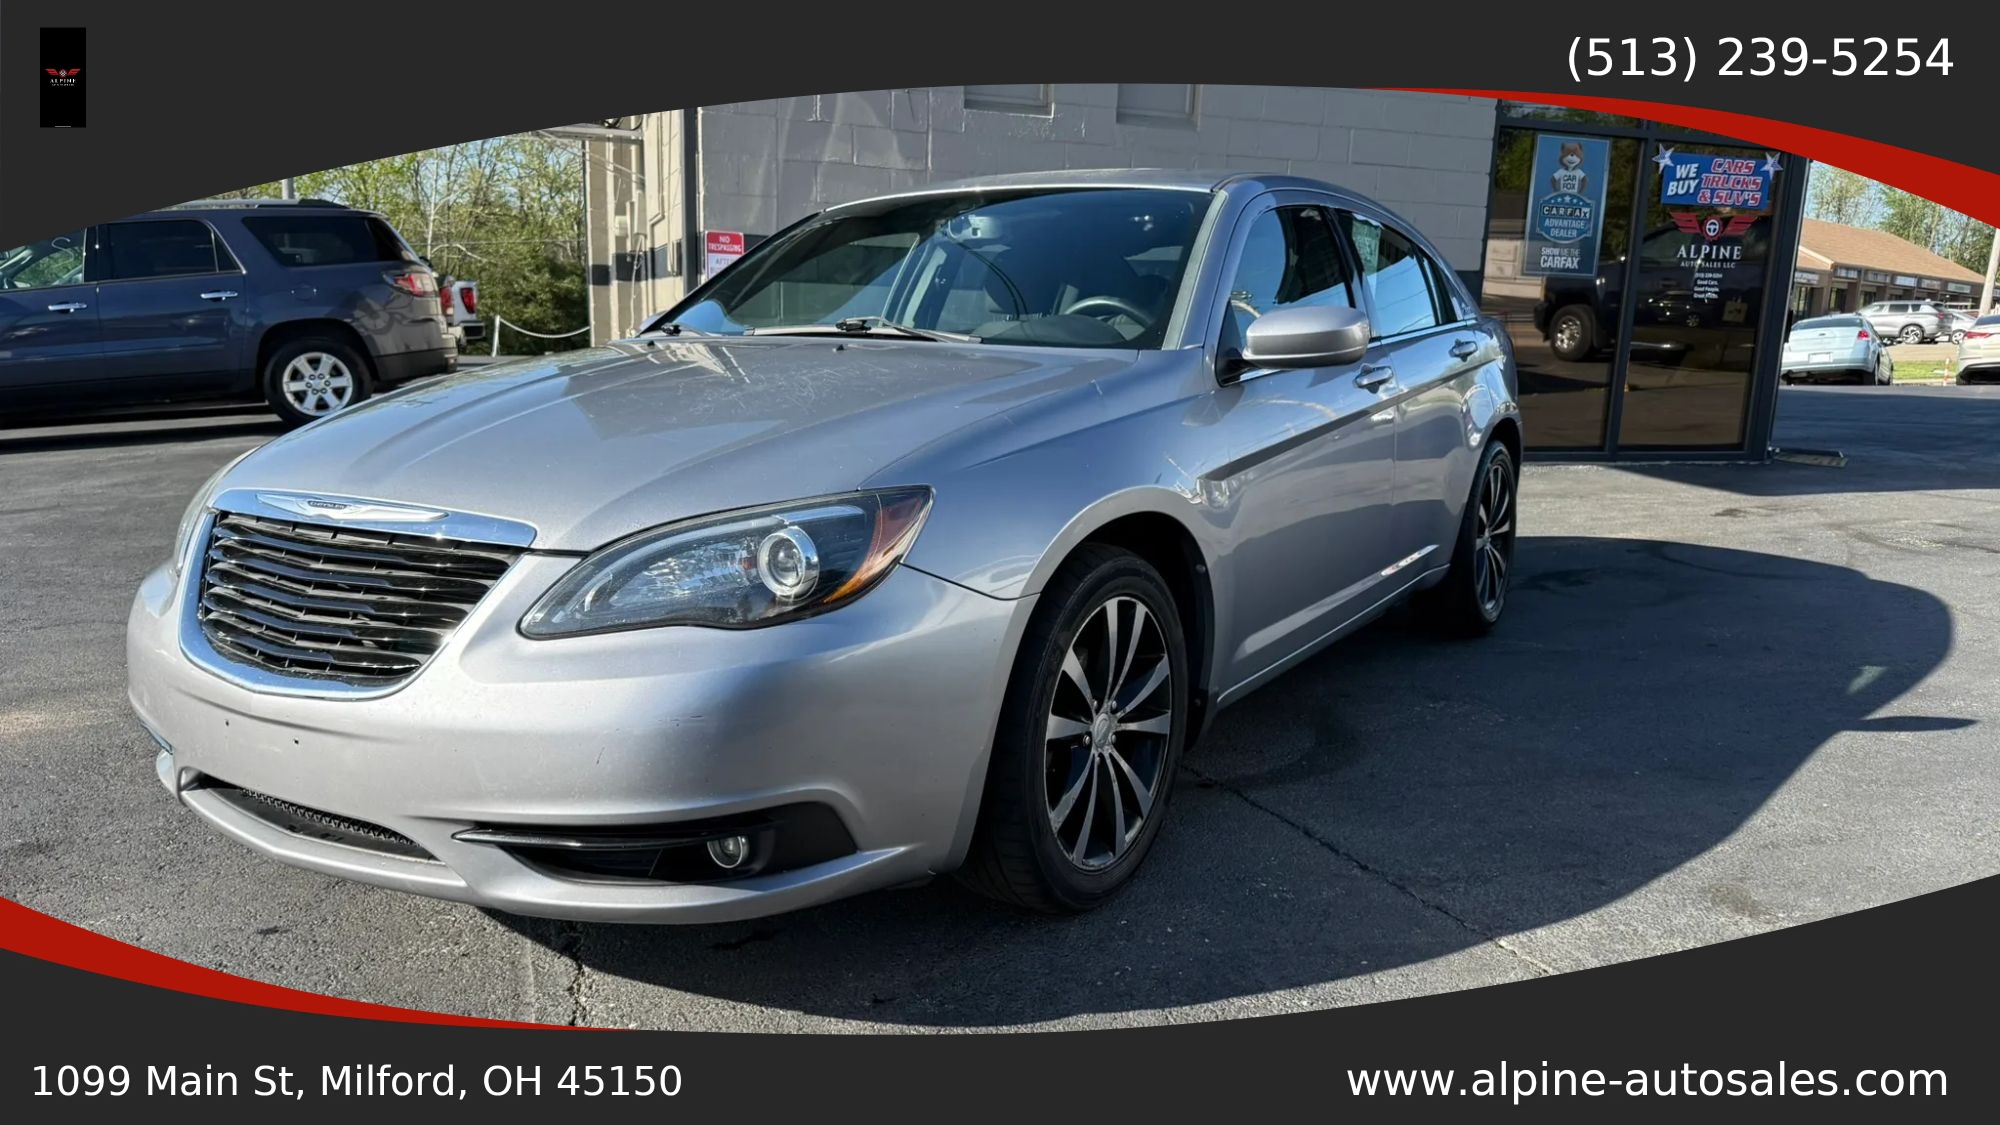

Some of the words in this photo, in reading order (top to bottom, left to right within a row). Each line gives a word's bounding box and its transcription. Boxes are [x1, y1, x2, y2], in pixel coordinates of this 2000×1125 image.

[1676, 163, 1699, 179] WE
[1711, 158, 1756, 174] CARS
[1562, 174, 1576, 182] CAR
[1701, 173, 1763, 191] TRUCKS
[1562, 182, 1576, 191] FOX
[1667, 180, 1699, 196] BUY
[1697, 189, 1711, 204] &
[1712, 190, 1762, 206] SUV'S
[1543, 206, 1590, 219] CARFAX
[1544, 218, 1585, 229] ADVANTAGE
[1550, 229, 1578, 237] DEALER
[1541, 247, 1560, 256] SHOW
[1560, 248, 1569, 256] ME
[1569, 248, 1580, 257] THE
[1677, 244, 1742, 260] ALPINE
[1540, 256, 1580, 269] CARFAX
